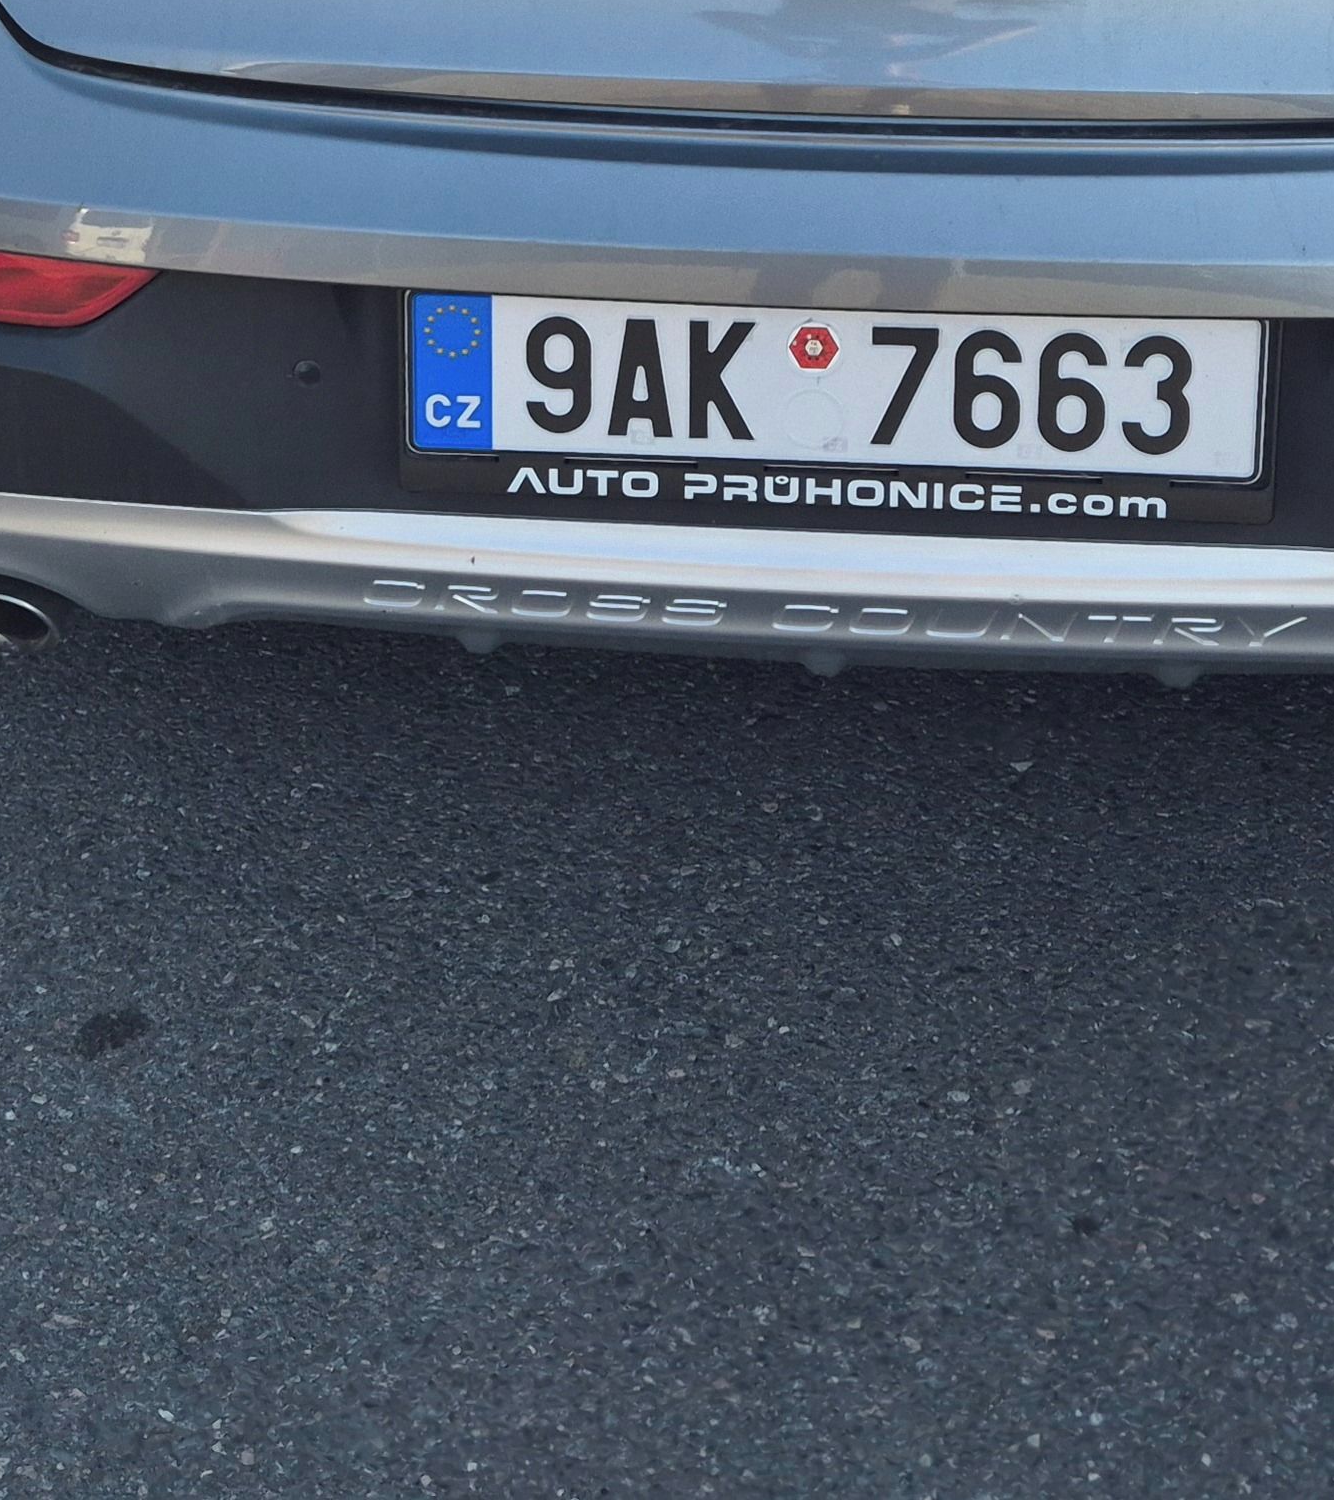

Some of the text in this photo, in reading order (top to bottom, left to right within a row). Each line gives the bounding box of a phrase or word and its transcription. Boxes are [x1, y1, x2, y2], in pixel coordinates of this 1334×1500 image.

[424, 394, 483, 429] CZ
[524, 315, 1193, 456] 9AK 7663
[507, 466, 660, 500] AUTO
[361, 578, 1309, 648] CROSS COUNTRY
